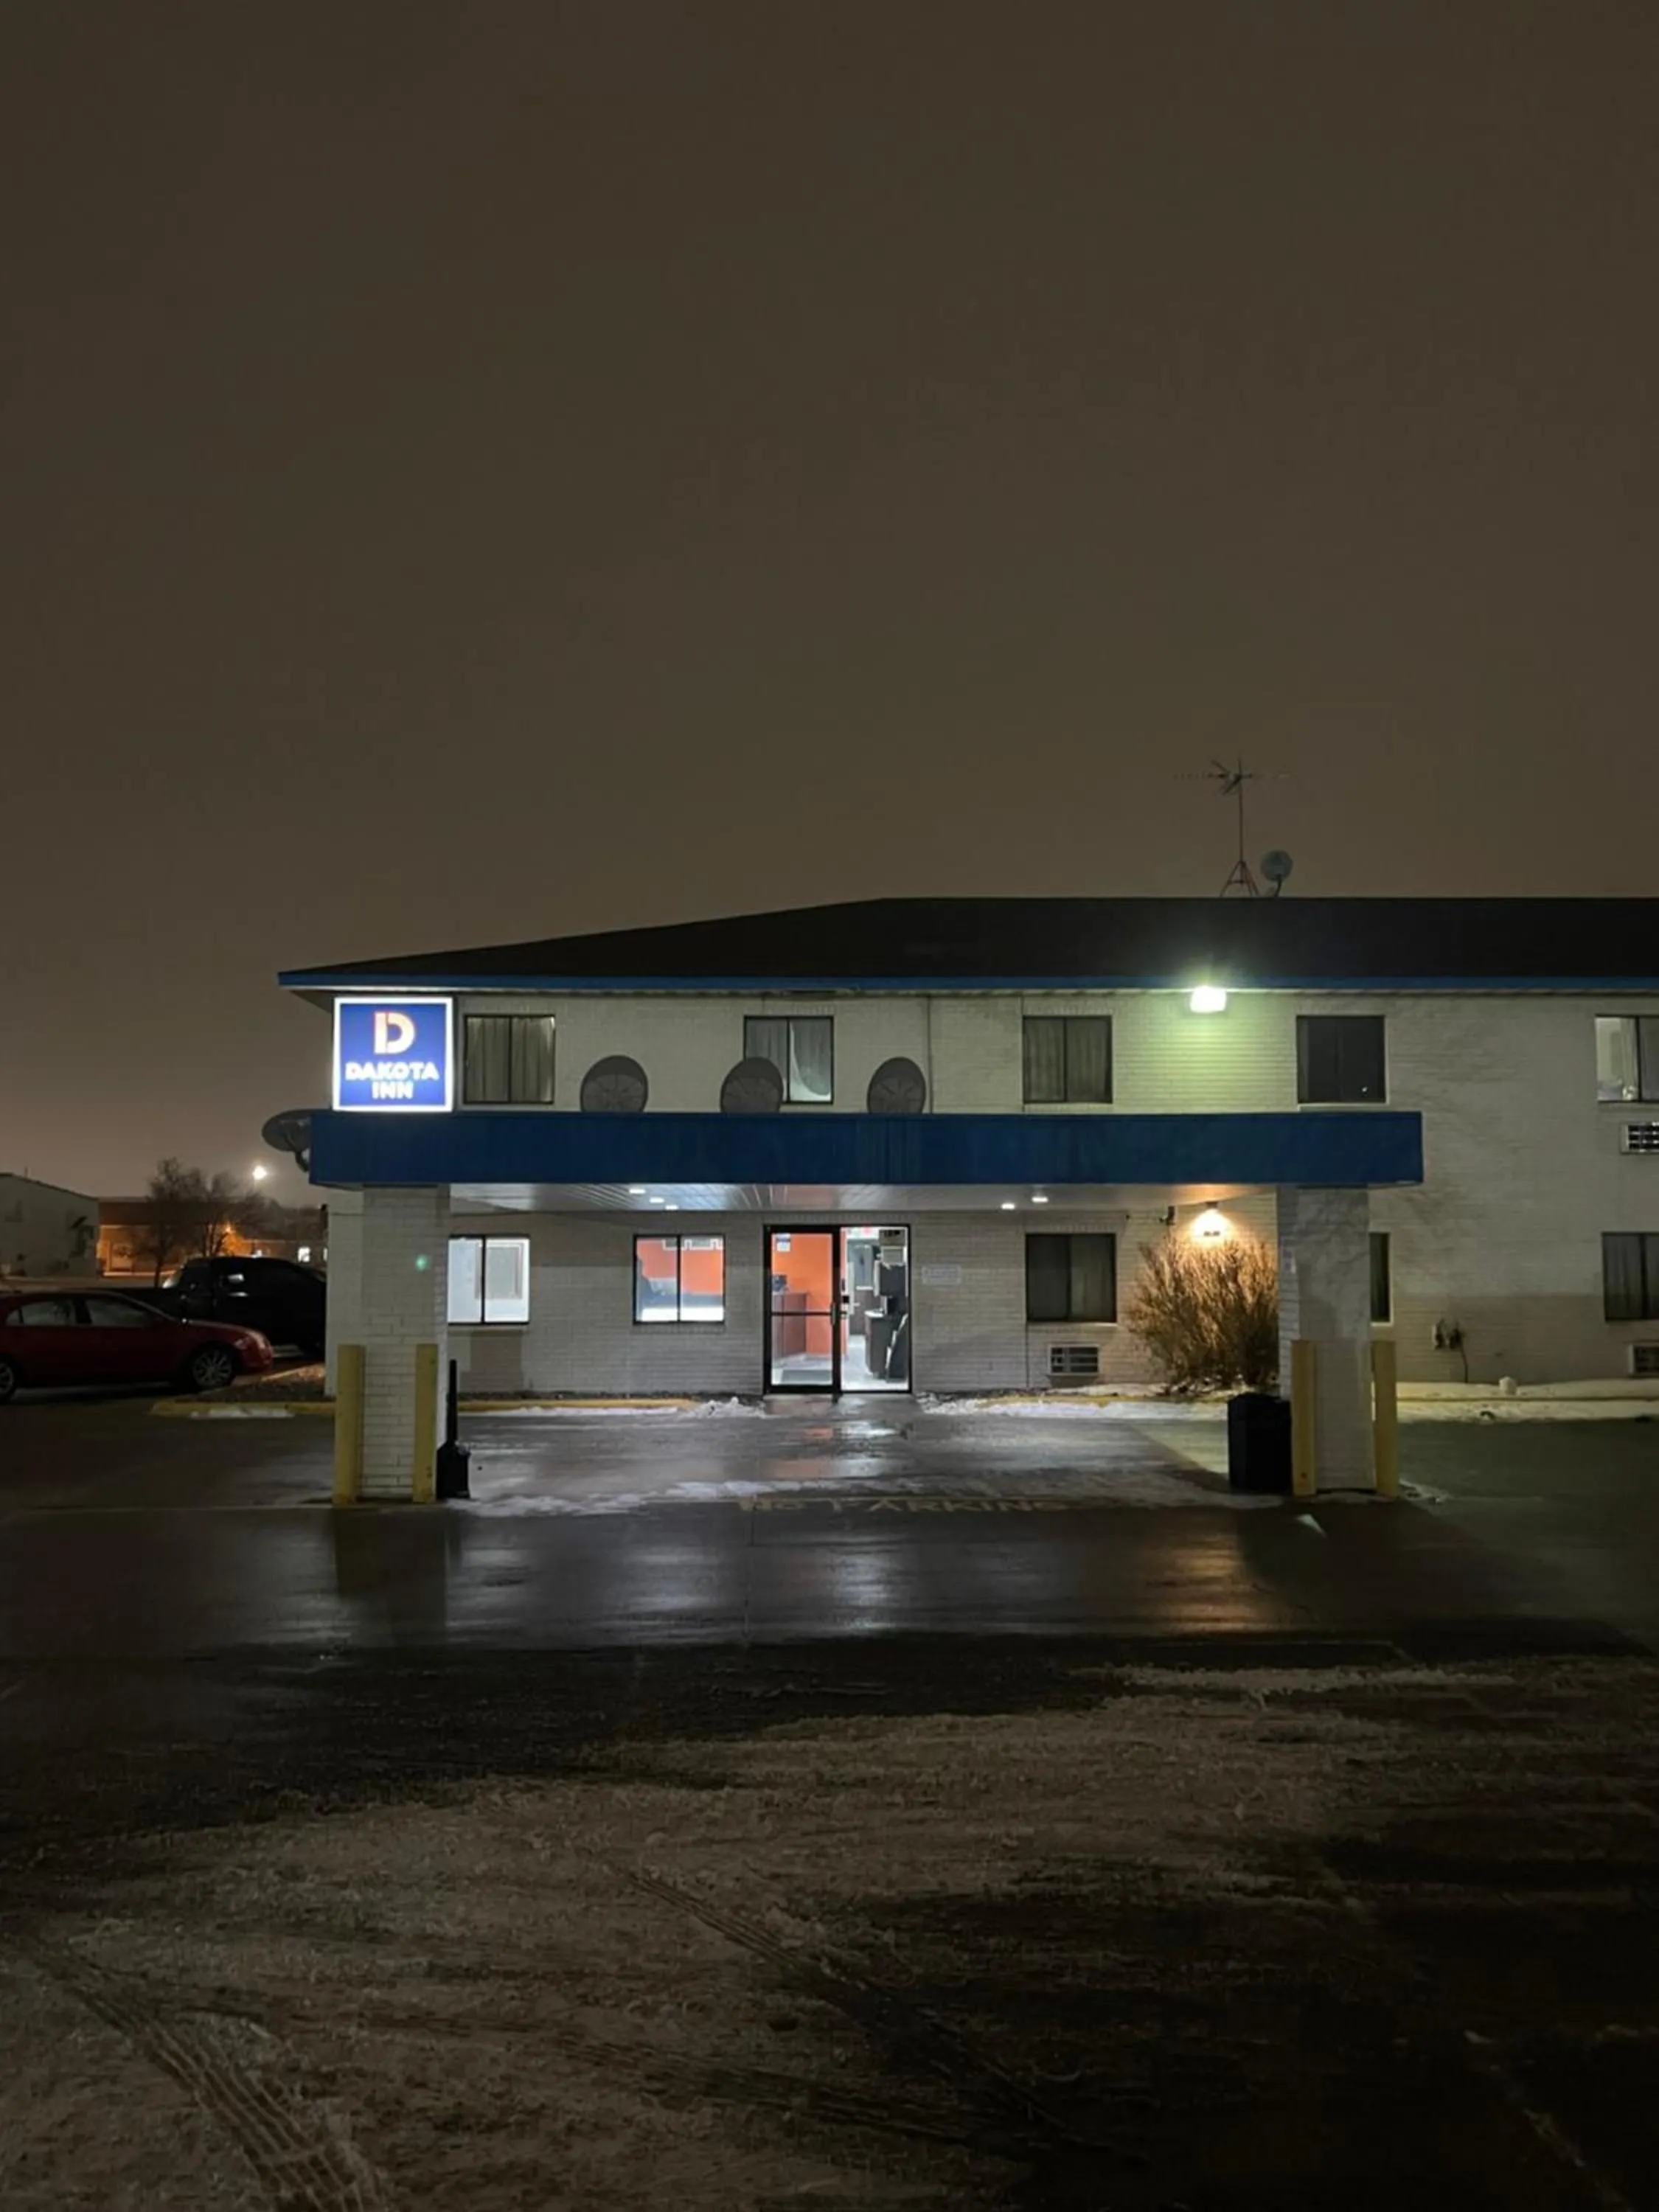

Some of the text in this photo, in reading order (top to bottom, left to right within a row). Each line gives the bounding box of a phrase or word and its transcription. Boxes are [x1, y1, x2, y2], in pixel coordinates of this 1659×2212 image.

[374, 1011, 415, 1054] D
[345, 1062, 439, 1080] DAKOTA
[372, 1080, 414, 1099] INN
